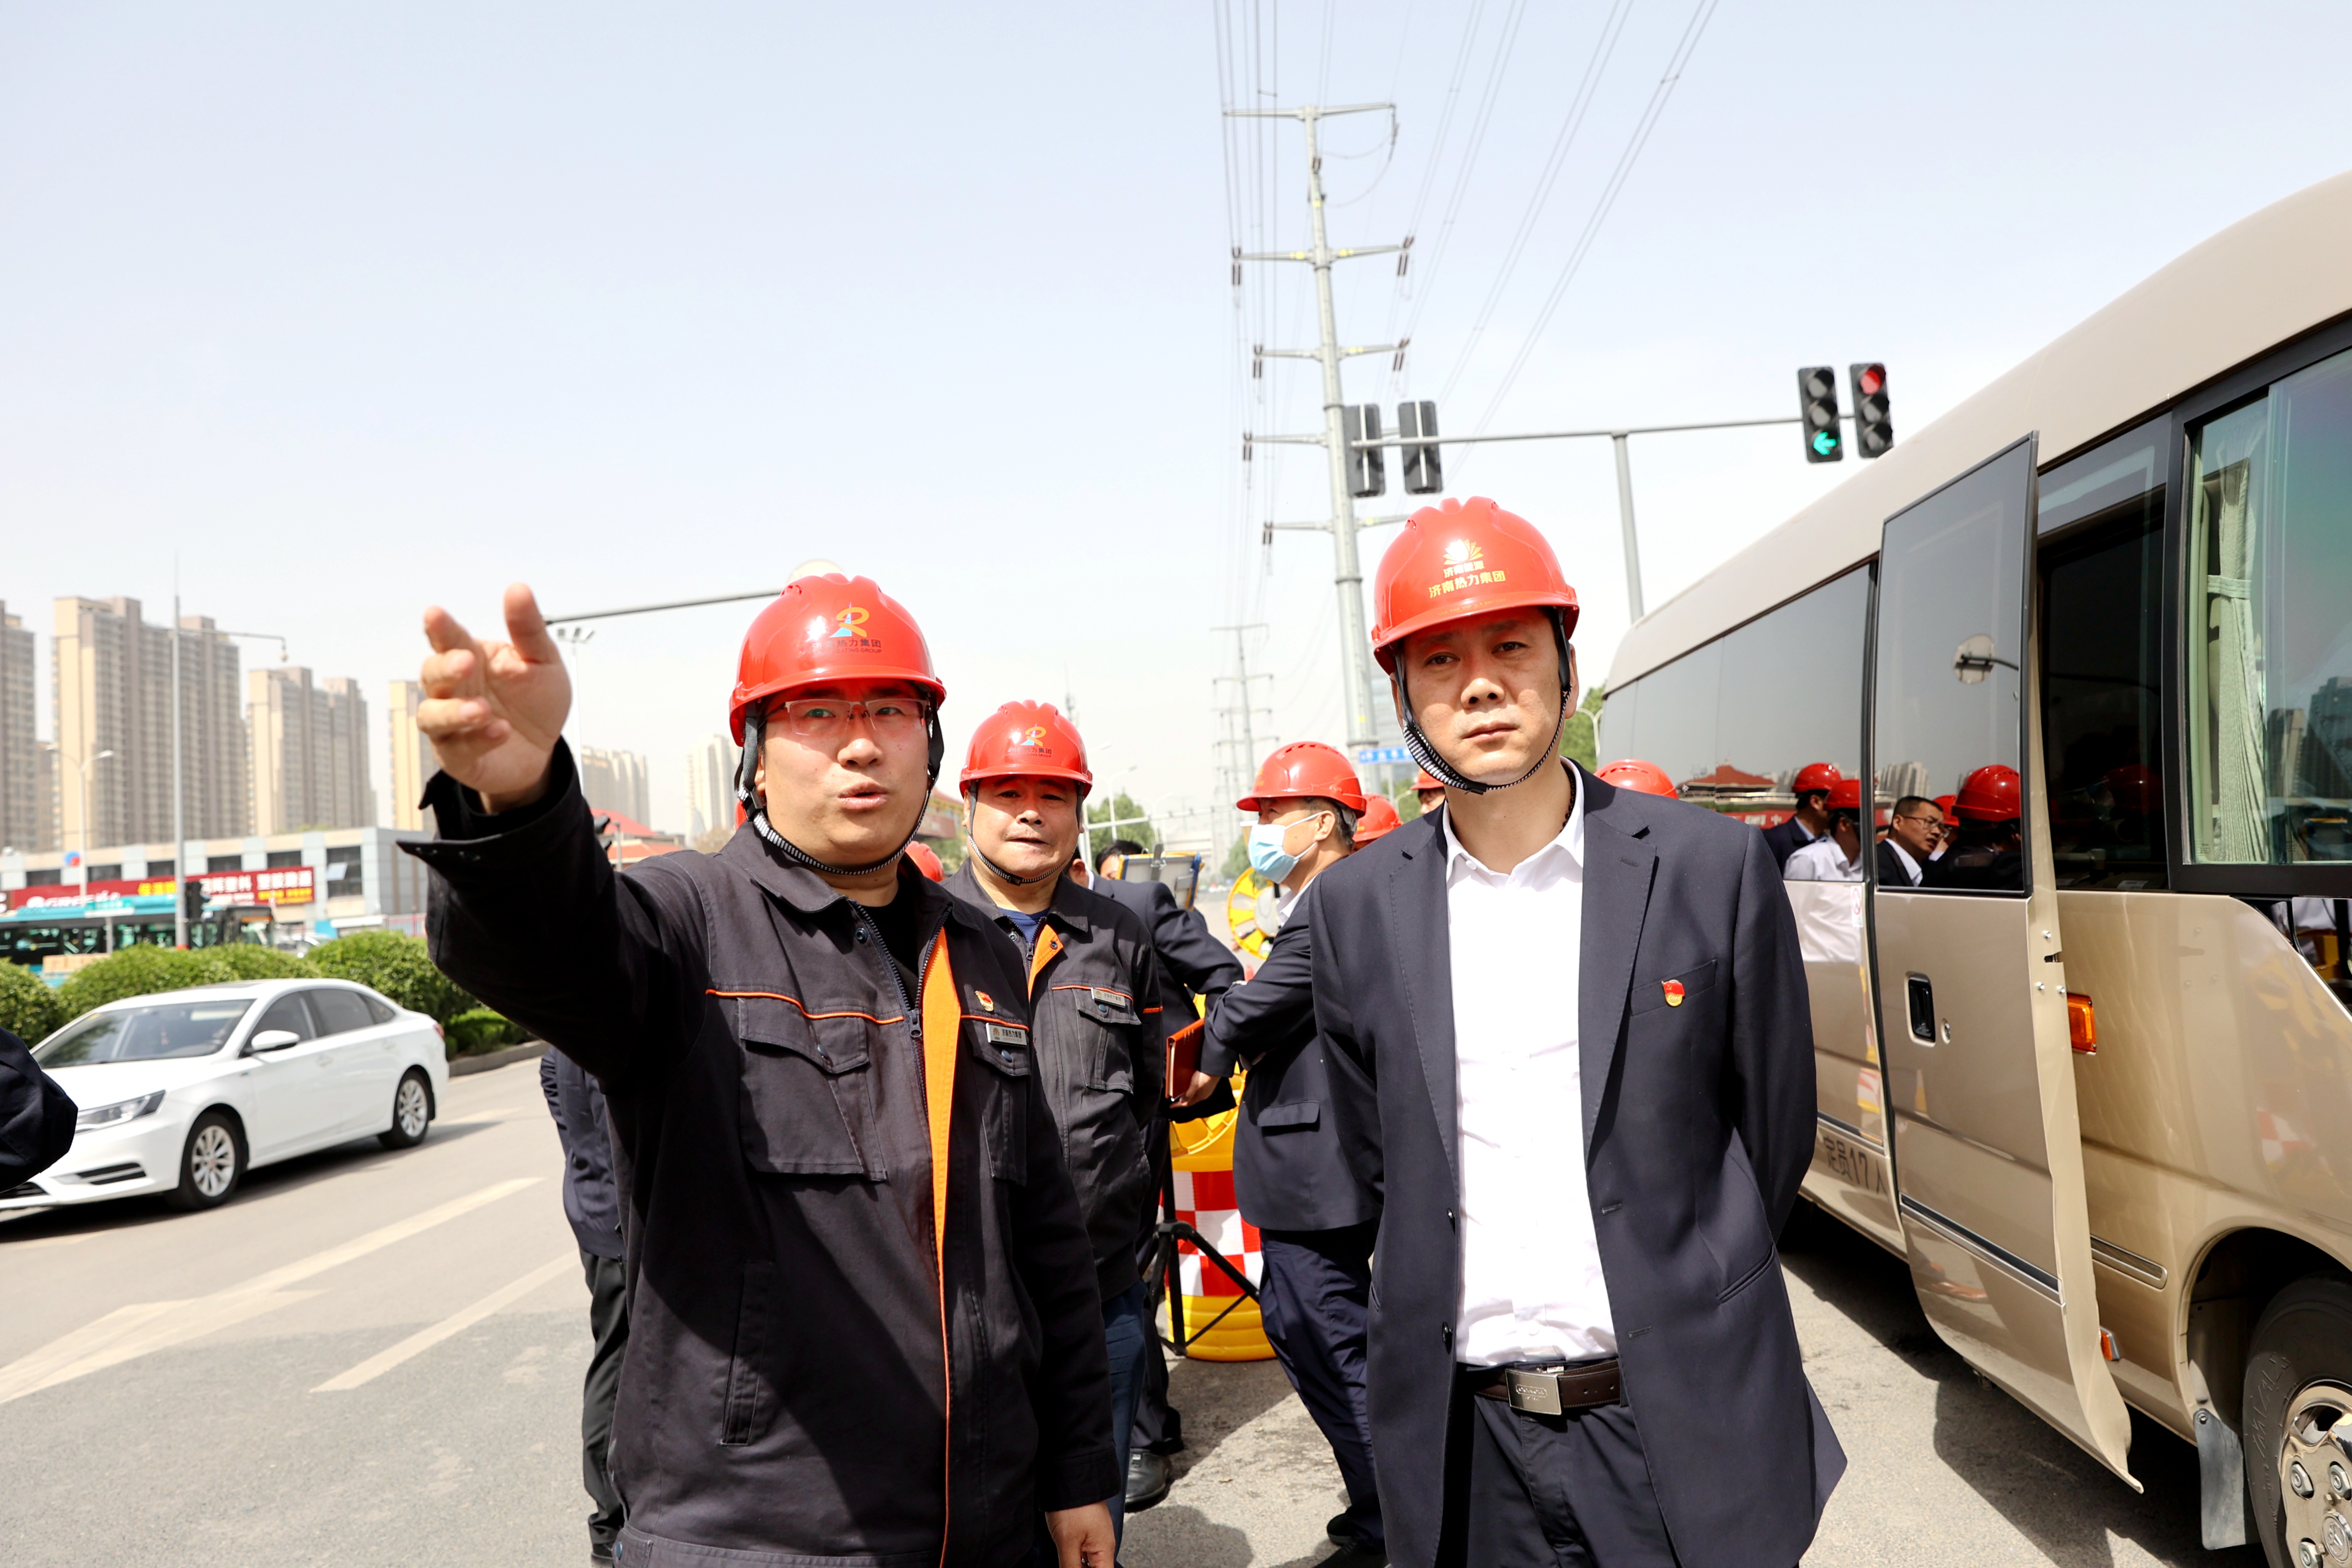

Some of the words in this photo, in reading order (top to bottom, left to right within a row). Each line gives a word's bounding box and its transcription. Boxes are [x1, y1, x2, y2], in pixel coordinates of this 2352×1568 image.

[1443, 560, 1485, 579] 济南能源
[1428, 570, 1506, 598] 济南热力集团
